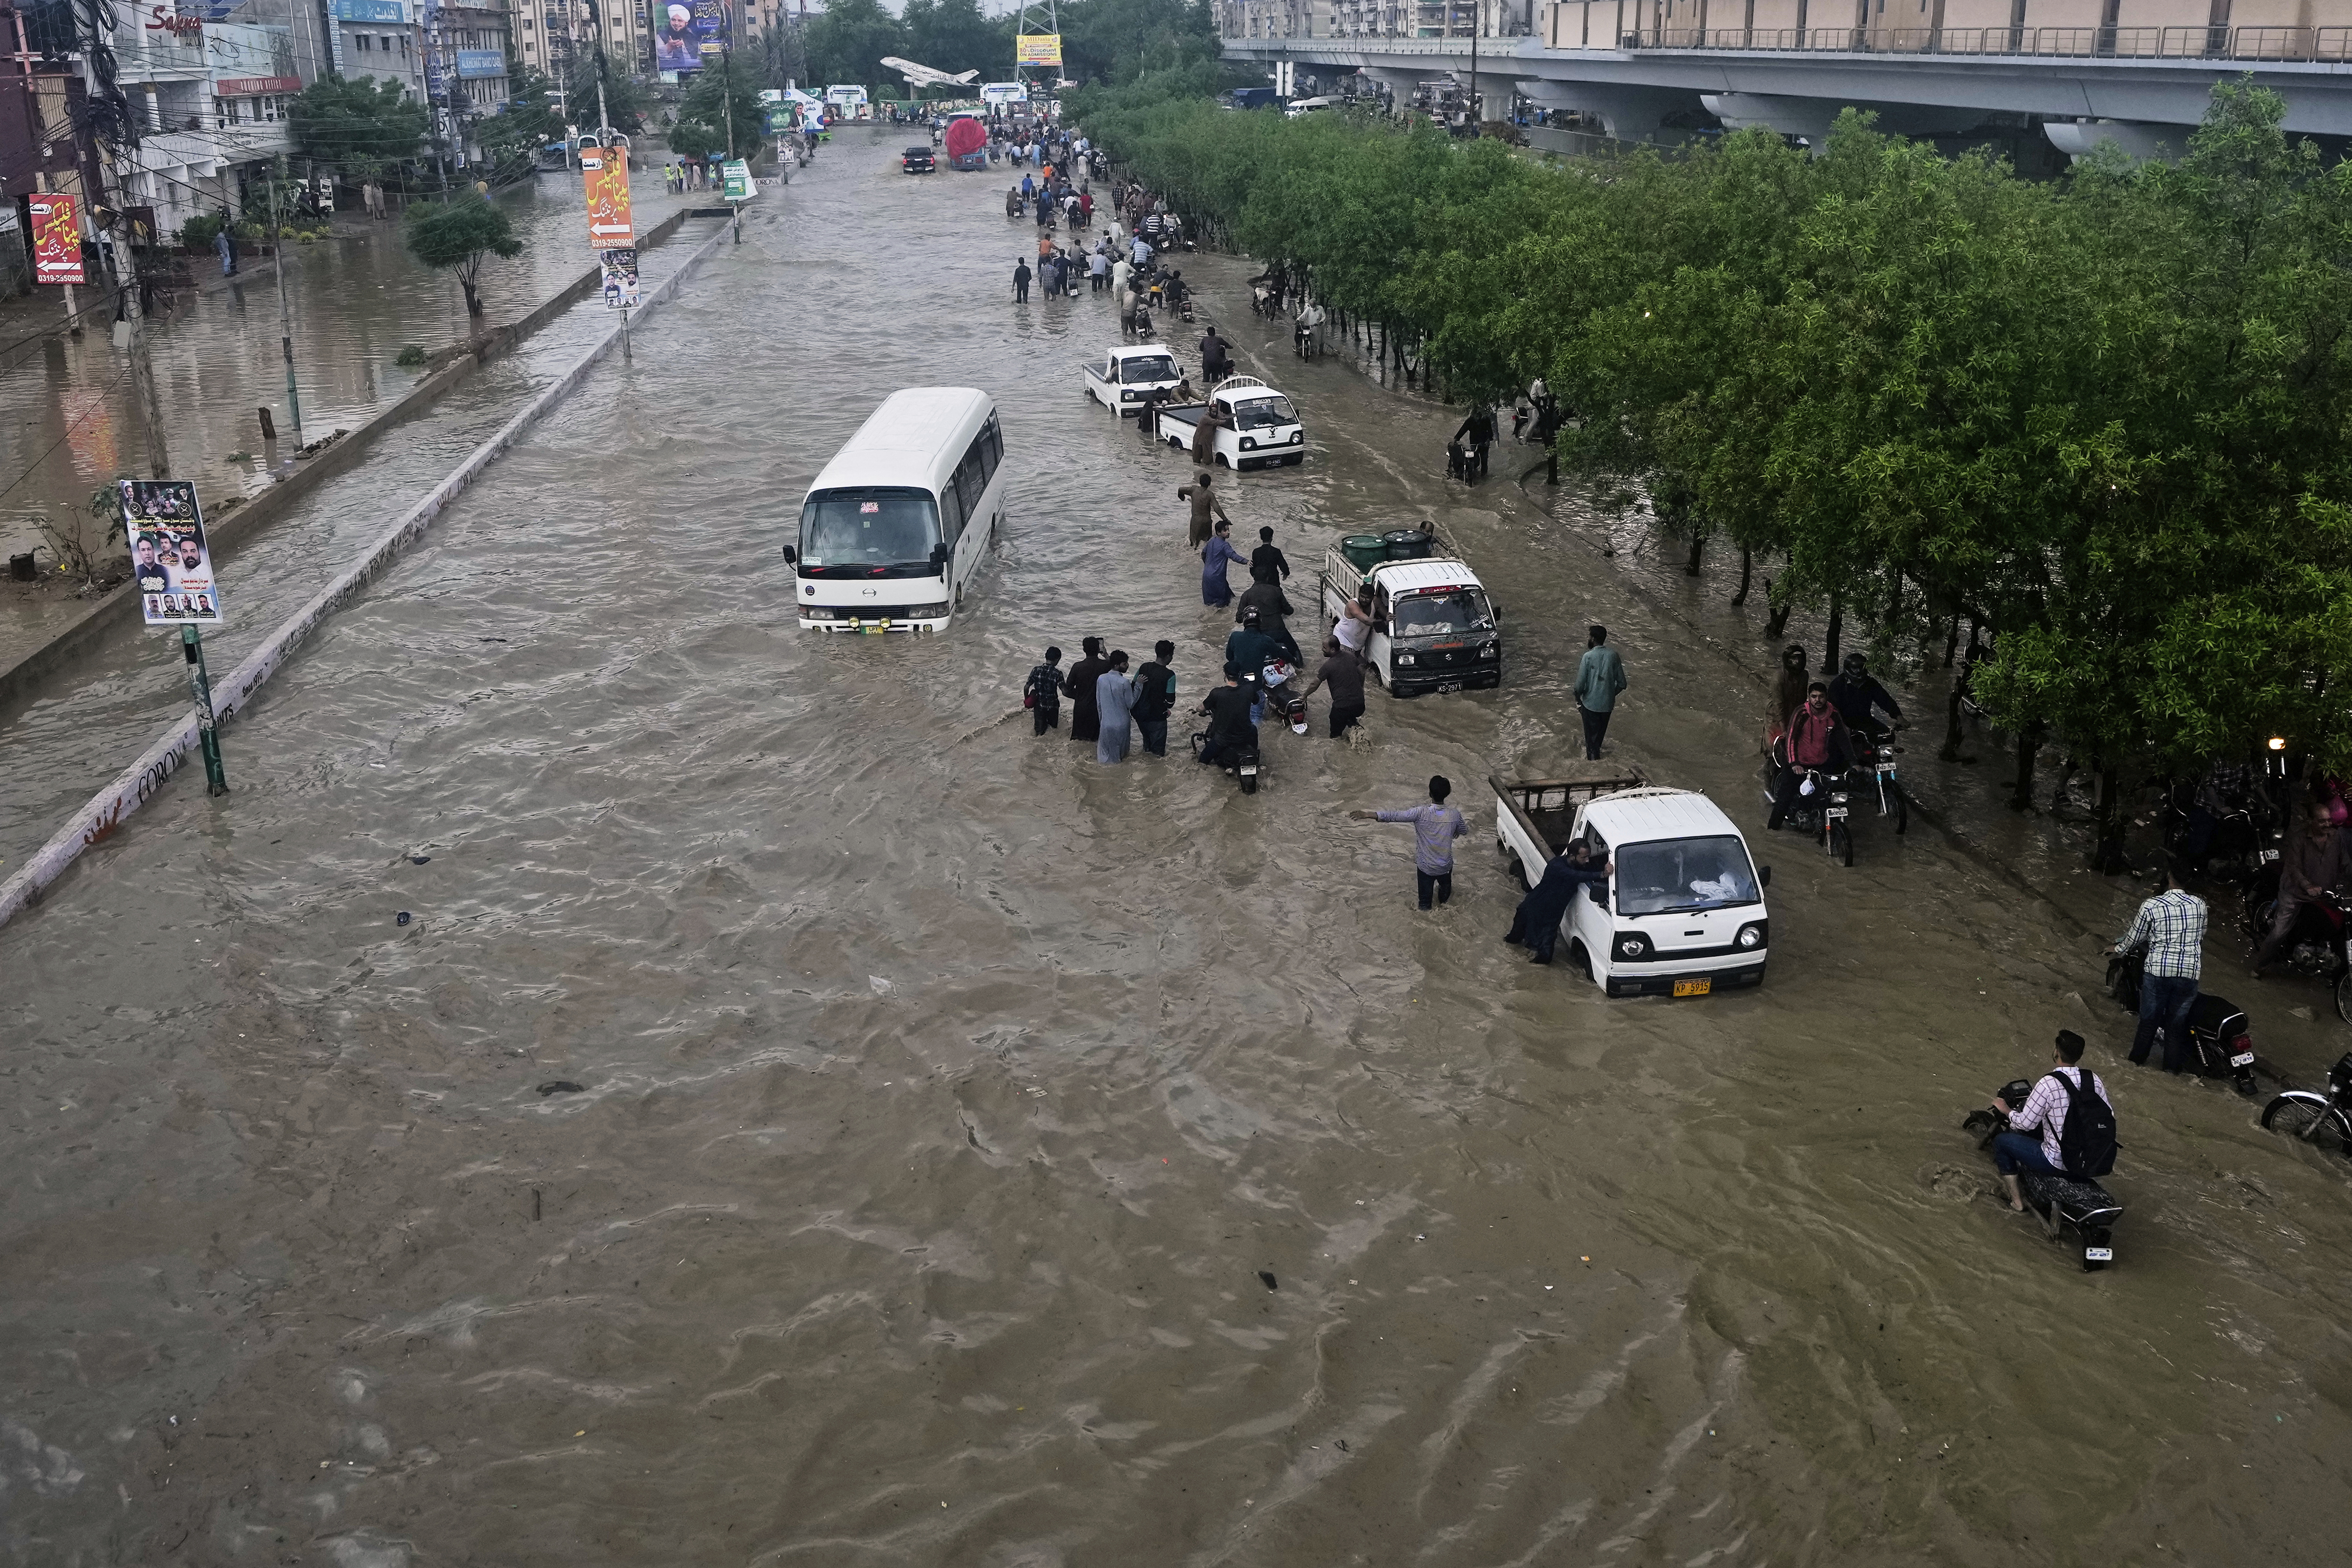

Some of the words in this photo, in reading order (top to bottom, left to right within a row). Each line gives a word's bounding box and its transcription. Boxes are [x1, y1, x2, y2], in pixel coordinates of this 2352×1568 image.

[591, 238, 632, 247] 0319-2550900
[1676, 984, 1685, 993] KP
[1691, 982, 1708, 992] 5915
